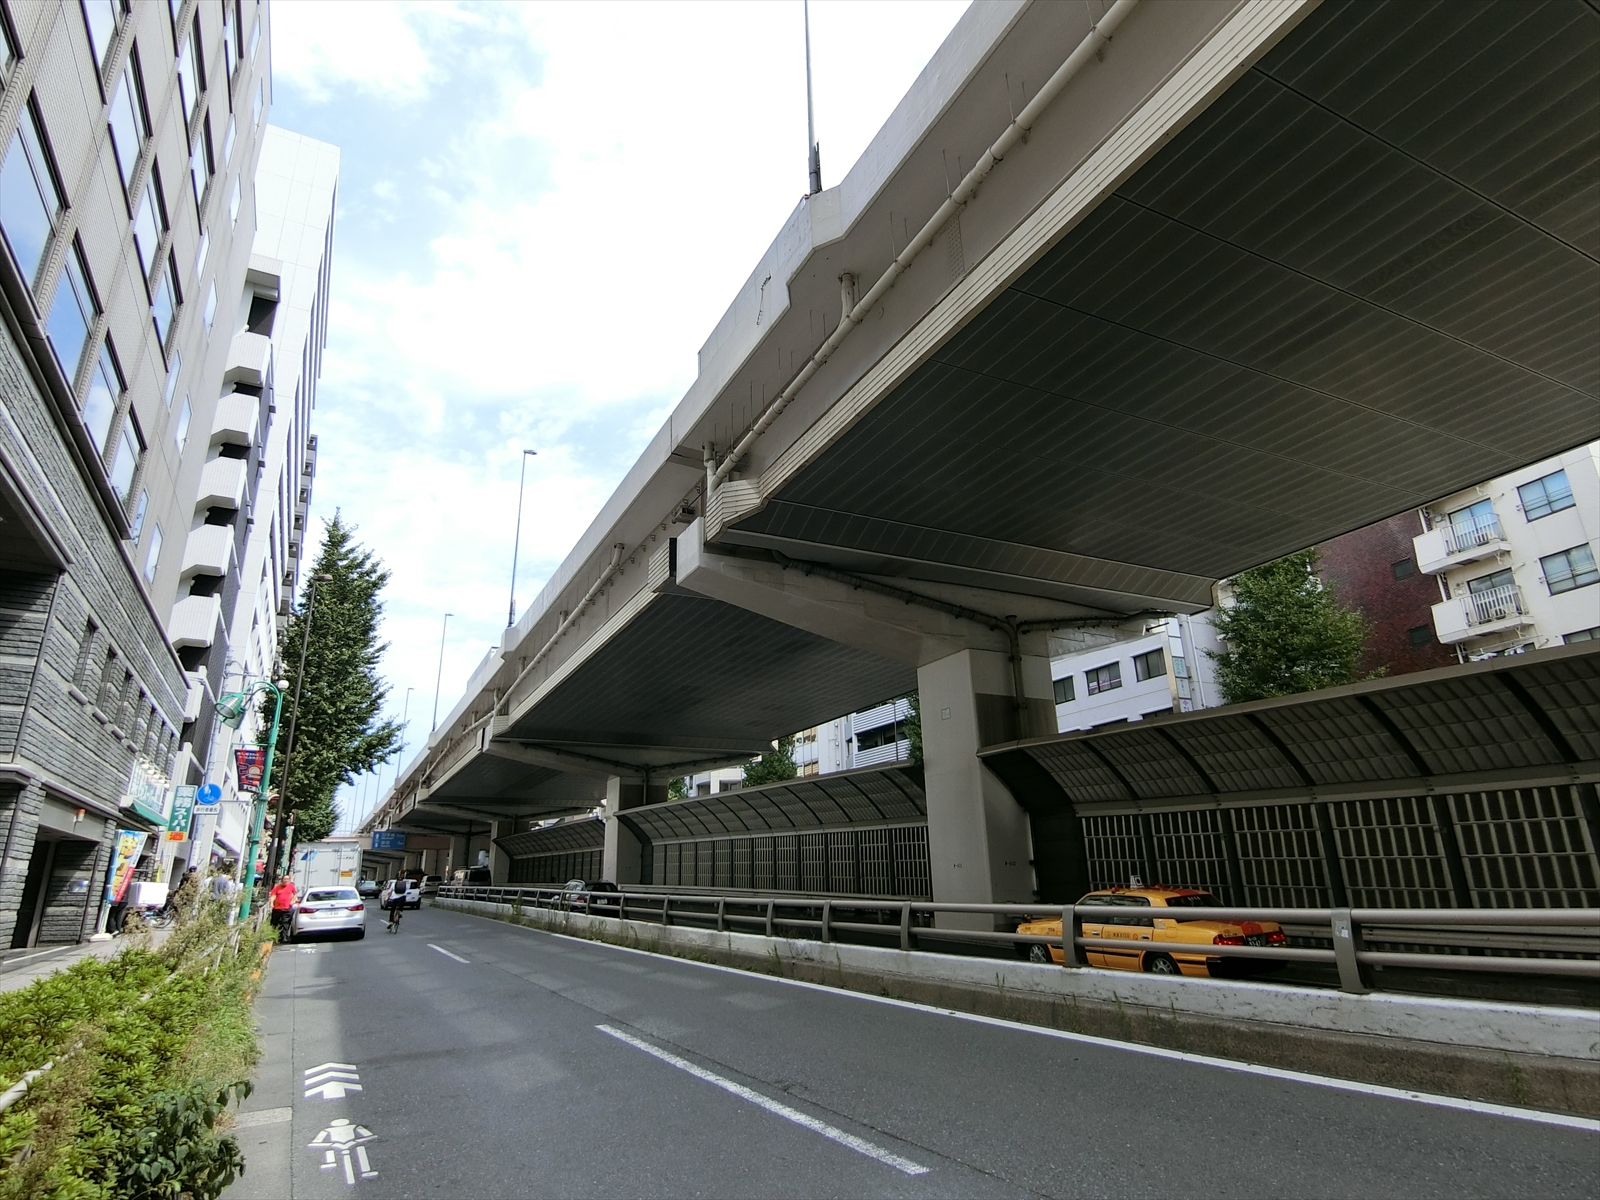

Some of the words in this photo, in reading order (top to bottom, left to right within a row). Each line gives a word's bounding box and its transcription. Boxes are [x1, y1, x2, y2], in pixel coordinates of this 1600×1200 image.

[172, 787, 195, 832] 業務スーパー
[169, 831, 184, 841] 酒
